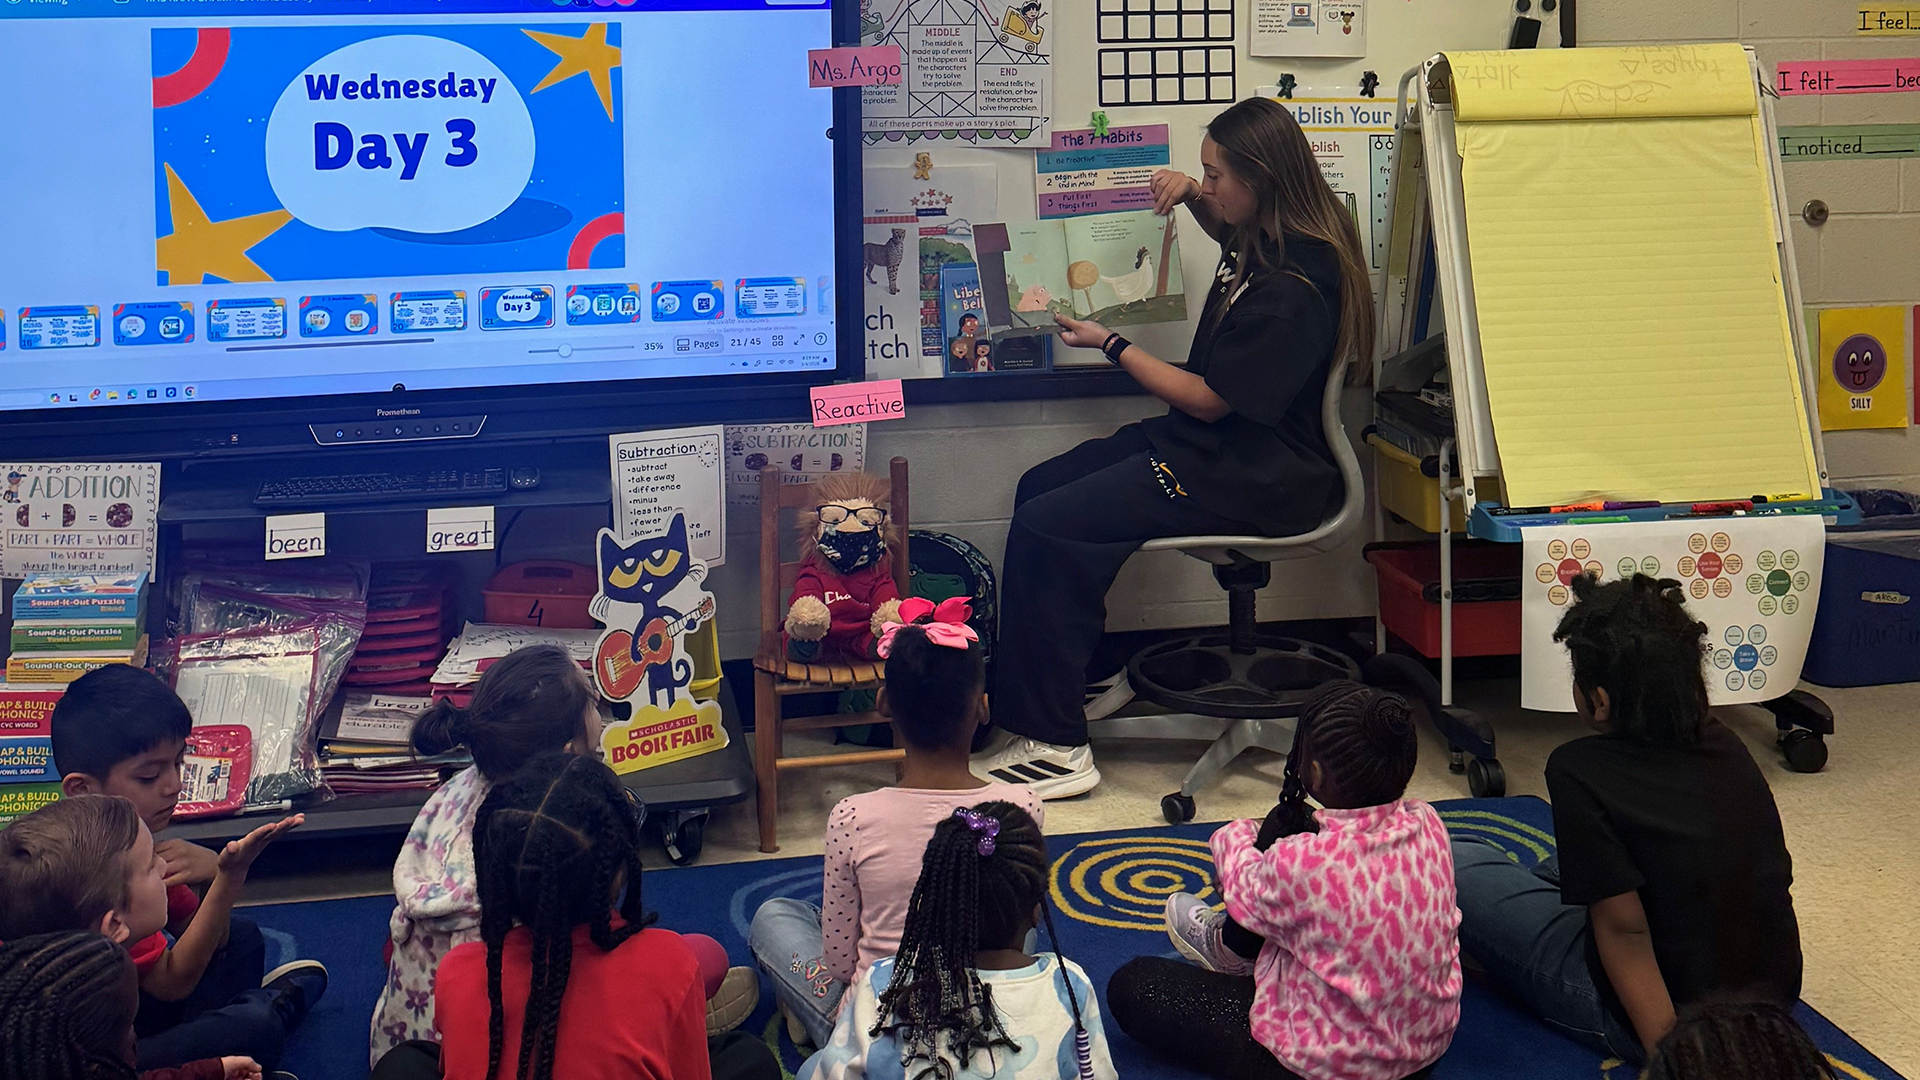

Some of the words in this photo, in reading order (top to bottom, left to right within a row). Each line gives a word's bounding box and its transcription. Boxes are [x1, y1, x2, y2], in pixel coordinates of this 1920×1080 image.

[1858, 11, 1873, 30] I
[926, 28, 960, 36] MIDDLE
[932, 56, 959, 64] happen
[812, 58, 847, 81] Ms.
[850, 56, 900, 85] Argo
[1000, 68, 1018, 76] END
[934, 80, 964, 88] problem.
[1778, 71, 1794, 92] I
[1800, 70, 1834, 91] felt
[304, 71, 497, 104] Wednesday
[1010, 104, 1038, 112] problem.
[1350, 106, 1392, 124] Your
[868, 120, 878, 128] All
[879, 120, 888, 128] of
[890, 120, 910, 128] these
[911, 120, 933, 128] parts
[974, 120, 999, 128] story's
[1100, 130, 1143, 144] Habits
[314, 122, 430, 180] Day
[444, 118, 478, 168] 3
[1780, 136, 1791, 156] I
[1797, 135, 1862, 155] noticed
[1046, 178, 1052, 186] 2
[1054, 174, 1072, 183] Begin
[1058, 181, 1070, 189] End
[1058, 202, 1080, 212] Things
[504, 302, 524, 314] Day
[524, 302, 532, 311] 3
[644, 341, 664, 351] 35%
[694, 338, 720, 349] Pages
[730, 338, 742, 347] 21
[750, 338, 762, 346] 45
[814, 394, 904, 420] Reactive
[1851, 398, 1871, 409] SILLY
[376, 408, 421, 417] Promethean
[746, 432, 854, 448] SUBTRACTION
[619, 443, 697, 460] Subtraction
[631, 463, 668, 473] subtract
[654, 474, 675, 482] away
[28, 475, 141, 499] ADDITION
[632, 484, 682, 494] difference
[632, 497, 658, 505] minus
[633, 508, 652, 516] less
[654, 506, 673, 514] than
[634, 518, 662, 526] fewer
[430, 521, 492, 551] great
[696, 529, 711, 539] left
[11, 533, 39, 546] PART
[53, 533, 82, 546] PART
[97, 533, 140, 546] WHOLE
[269, 529, 322, 554] been
[50, 551, 64, 559] The
[66, 550, 96, 560] WHOLE
[97, 551, 104, 560] is
[21, 562, 50, 572] always
[51, 562, 64, 570] the
[68, 562, 97, 572] largest
[30, 598, 90, 607] Sound-It-Out
[92, 598, 126, 606] Puzzles
[527, 599, 544, 627] 4
[27, 629, 87, 637] Sound-It-Out
[88, 628, 122, 636] Puzzles
[24, 662, 82, 670] Sound-It-Out
[14, 701, 23, 710] &
[24, 701, 56, 711] BUILD
[639, 716, 696, 736] SCHOLASTIC
[612, 734, 668, 764] BOOK
[670, 723, 715, 749] FAIR
[16, 746, 25, 756] &
[17, 792, 26, 802] &
[26, 792, 60, 801] BUILD
